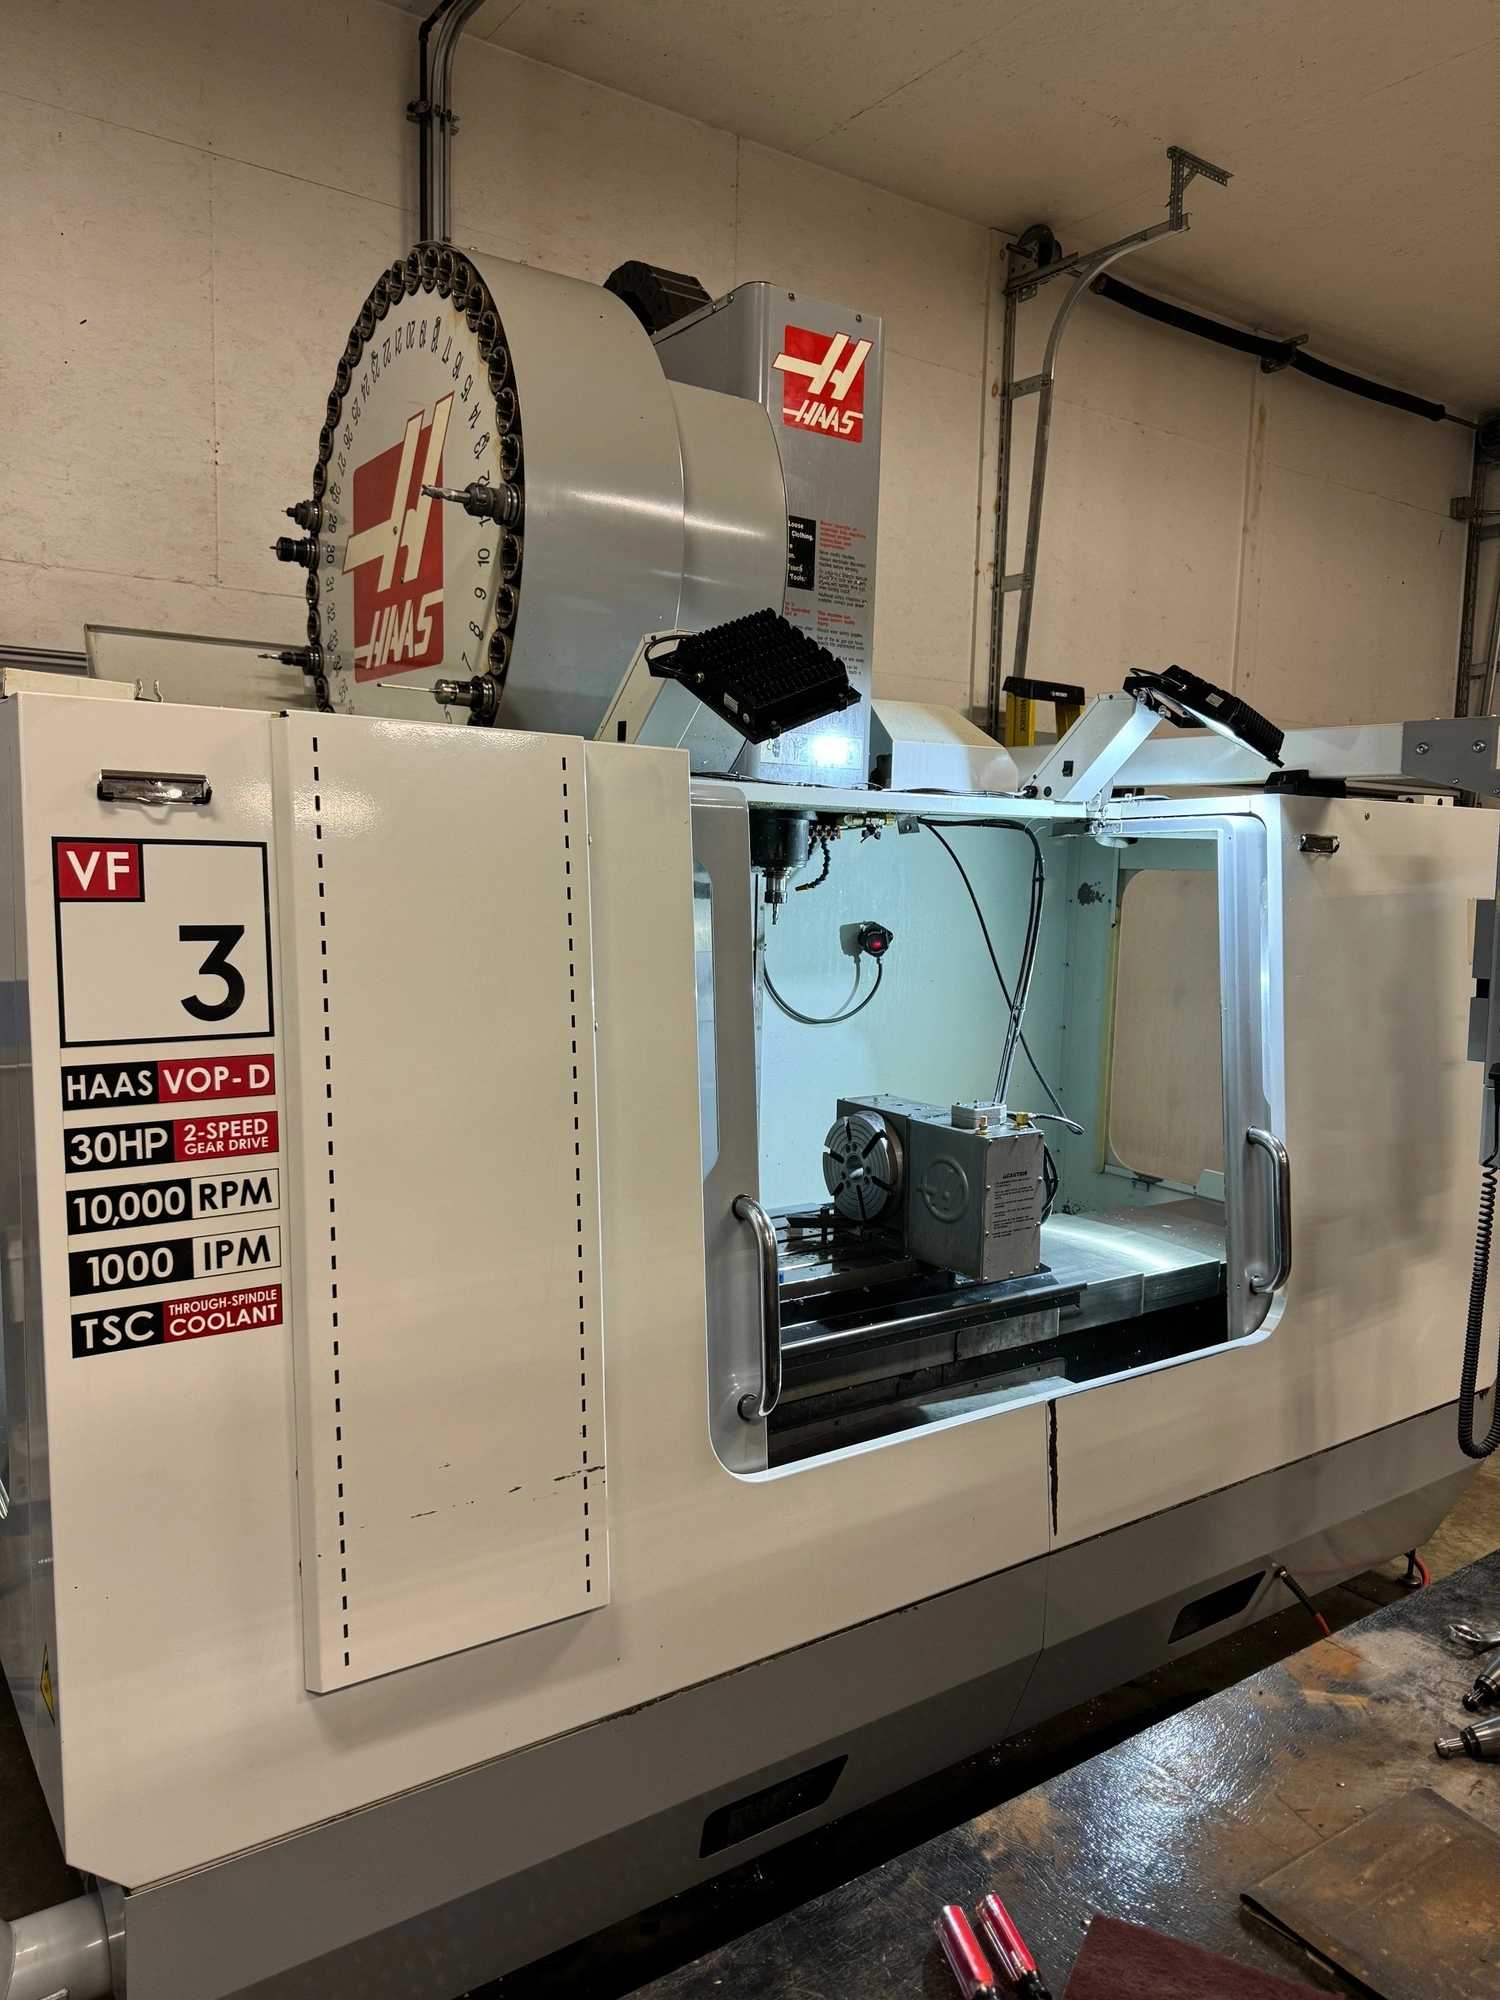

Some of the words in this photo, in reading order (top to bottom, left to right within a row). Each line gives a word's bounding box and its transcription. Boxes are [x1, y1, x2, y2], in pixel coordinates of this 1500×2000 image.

[395, 327, 402, 355] 21
[406, 320, 415, 349] 20
[383, 337, 391, 368] 22
[441, 336, 452, 364] 17
[461, 374, 473, 402] 15
[352, 397, 361, 426] 25
[468, 402, 481, 429] 14
[782, 399, 863, 435] HAAS
[343, 424, 353, 450] 26
[337, 452, 346, 476] 27
[328, 513, 337, 534] 29
[326, 544, 335, 564] 30
[478, 547, 491, 567] 10
[326, 576, 335, 593] 31
[474, 586, 487, 601] 9
[354, 587, 444, 670] HAAS
[469, 620, 482, 638] 8
[461, 651, 472, 672] 7
[66, 850, 130, 891] VF
[178, 924, 245, 1022] 3
[66, 1070, 153, 1102] HAAS
[184, 1118, 268, 1142] 2-SPEED
[70, 1127, 168, 1166] 30HP
[184, 1141, 225, 1156] GEAR
[228, 1136, 269, 1151] DRIVE
[72, 1186, 186, 1227] 10,000
[199, 1176, 272, 1212] RPM
[86, 1247, 174, 1287] 1000
[204, 1234, 271, 1272] IPM
[168, 1289, 277, 1317] THROUGH-SPINDLE
[80, 1310, 155, 1349] TSC
[169, 1304, 278, 1337] COOLANT
